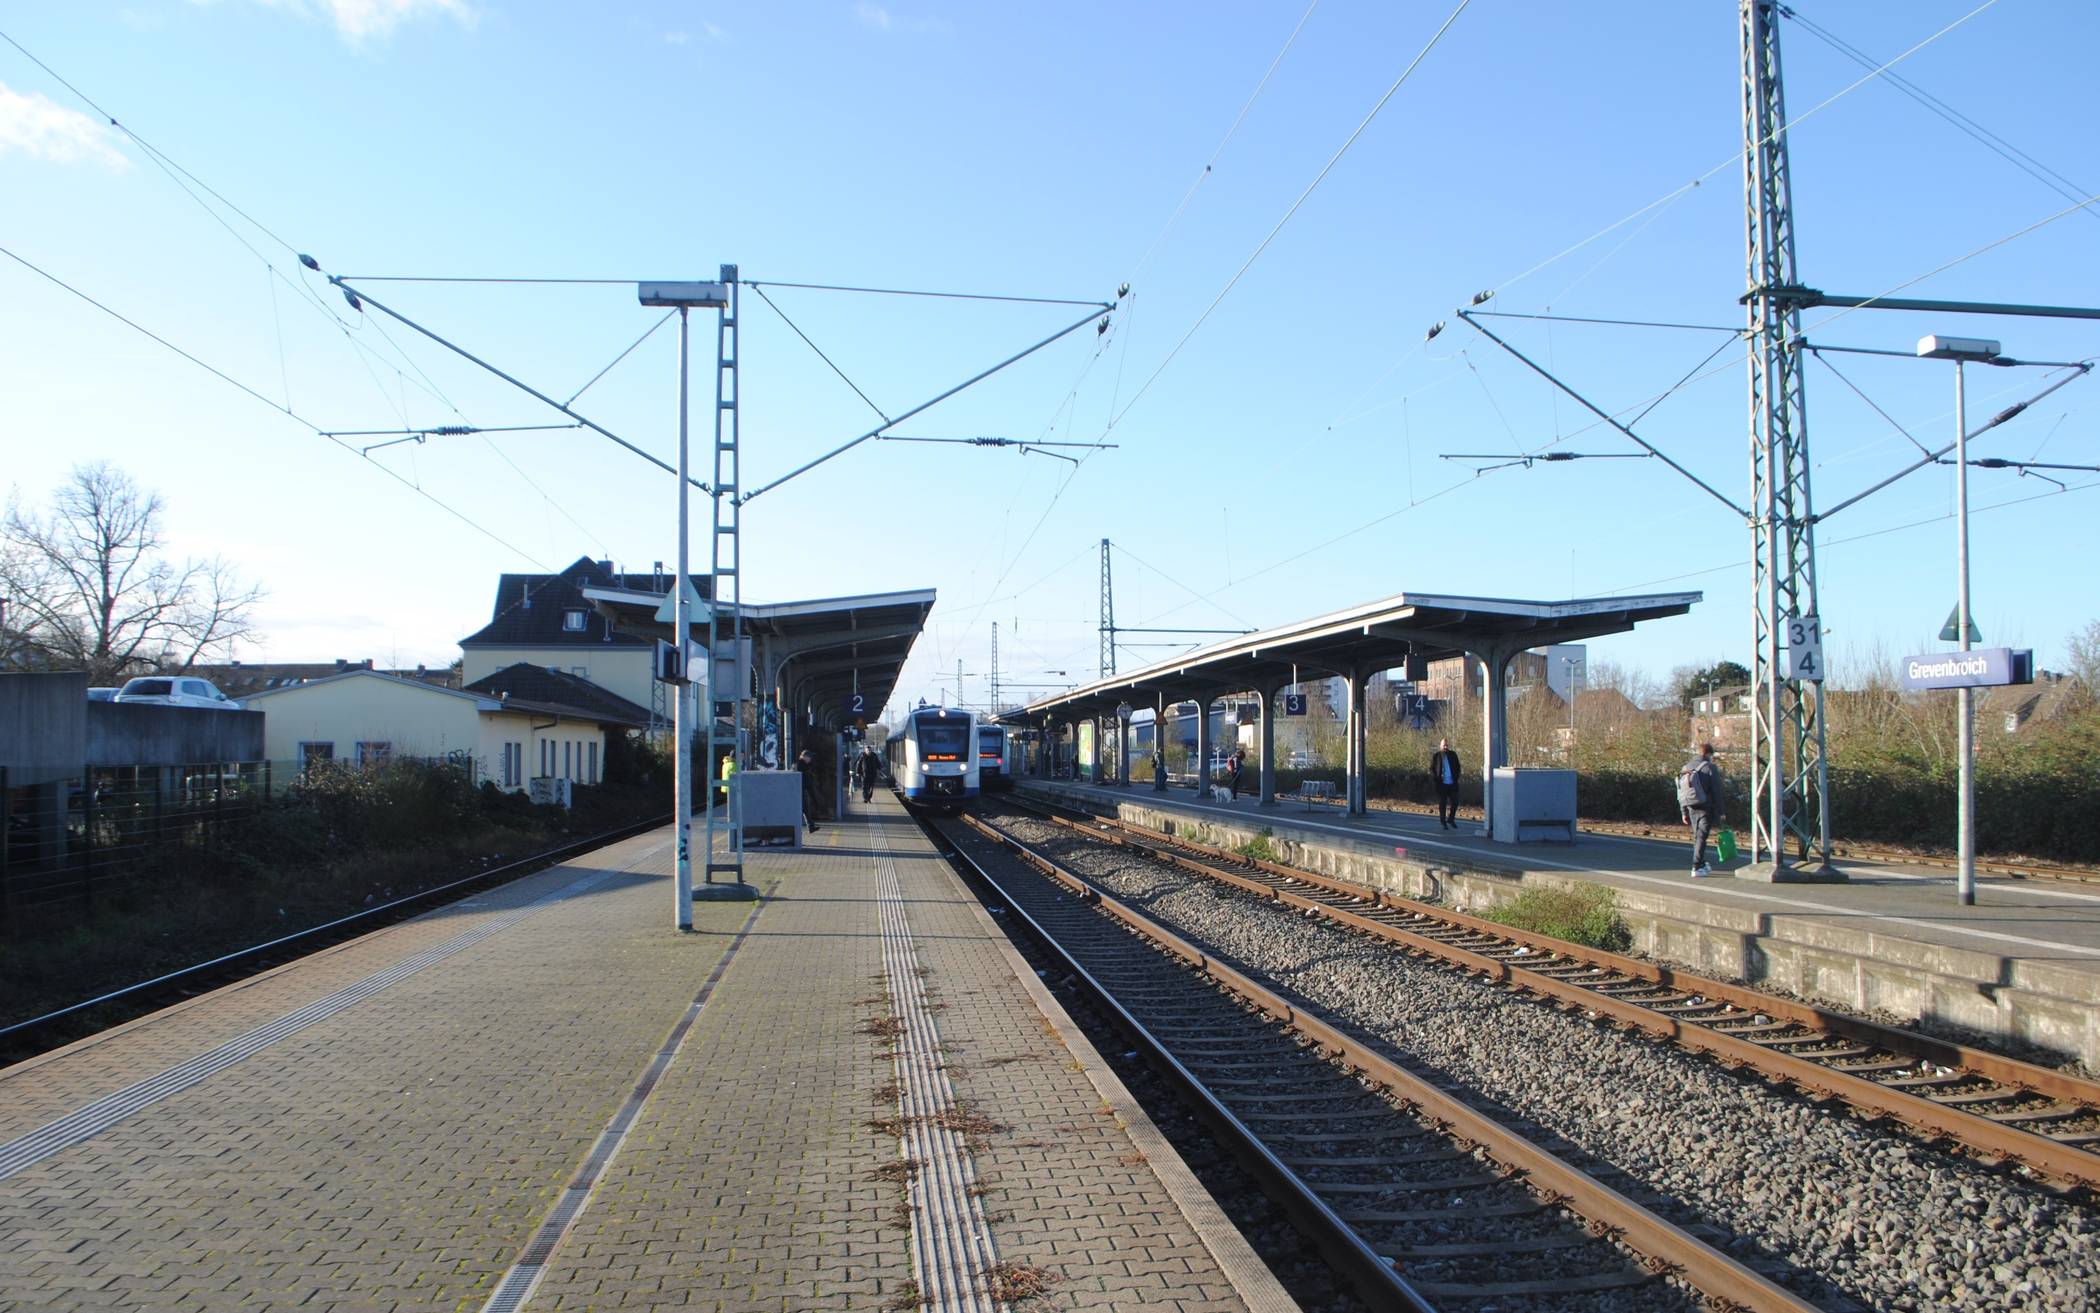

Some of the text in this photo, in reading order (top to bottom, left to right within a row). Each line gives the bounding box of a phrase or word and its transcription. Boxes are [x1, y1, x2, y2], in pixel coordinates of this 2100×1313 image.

[1791, 622, 1819, 645] 31
[1799, 651, 1816, 674] 4
[1908, 657, 1988, 680] Grevenbroich
[852, 695, 863, 711] 2
[1289, 695, 1299, 711] 3
[1415, 695, 1425, 711] 4
